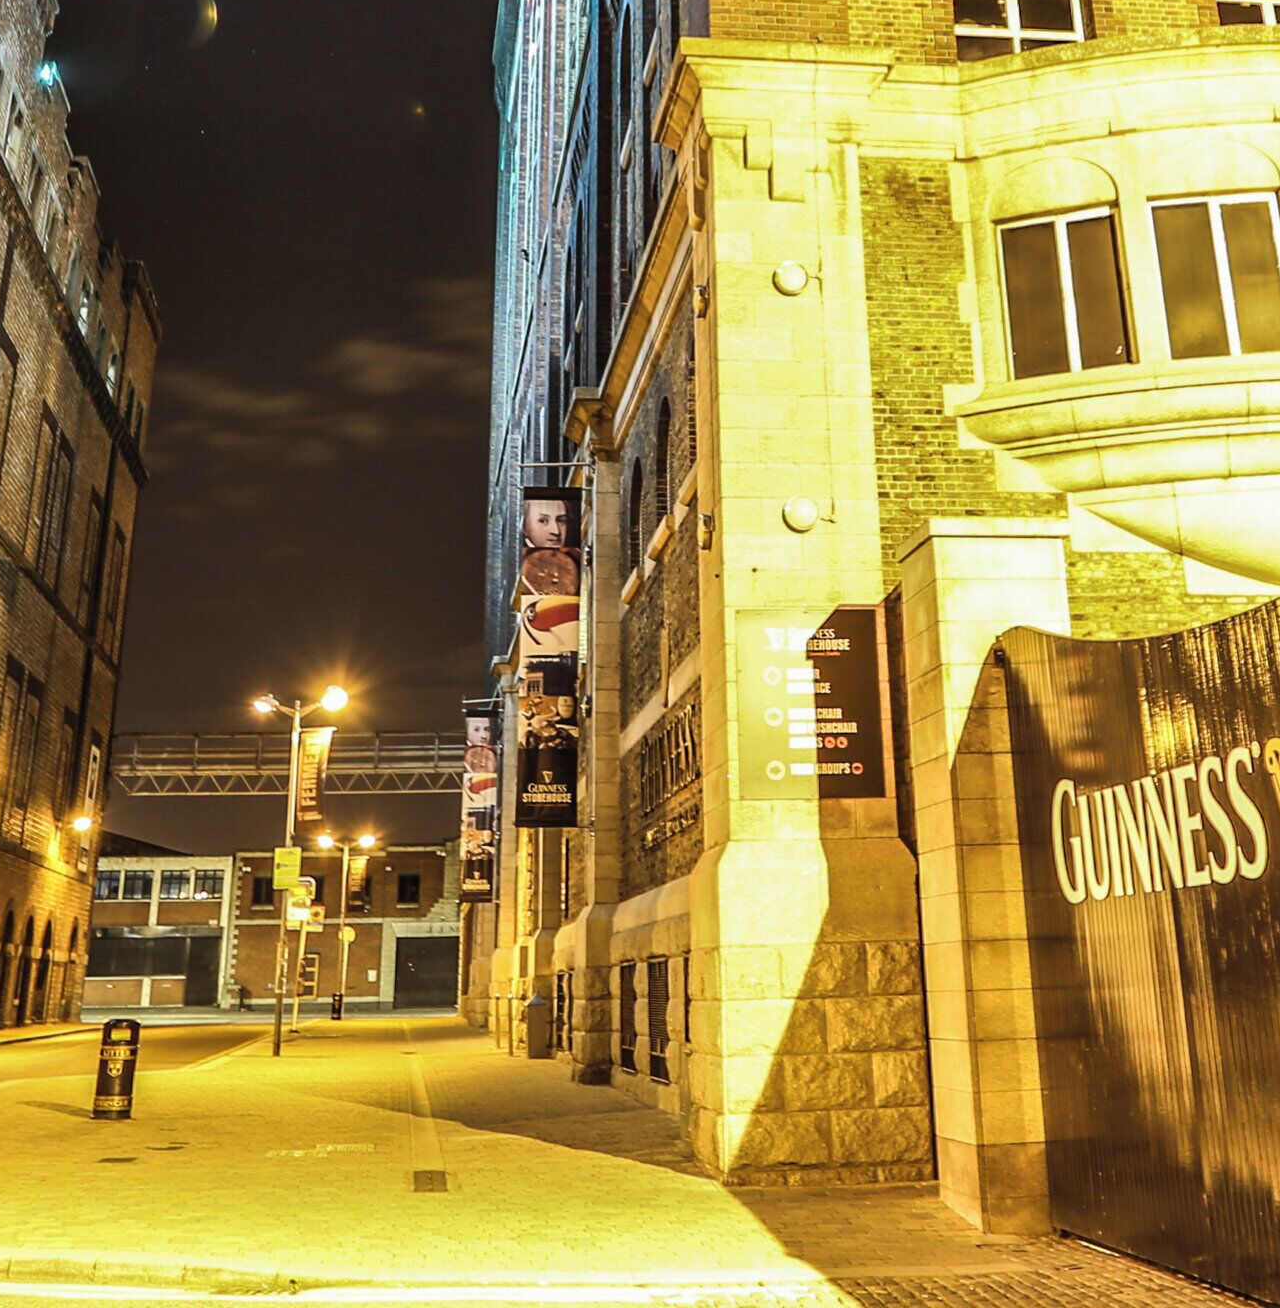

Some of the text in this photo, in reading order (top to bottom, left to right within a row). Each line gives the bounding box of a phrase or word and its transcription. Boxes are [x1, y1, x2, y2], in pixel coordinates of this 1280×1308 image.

[527, 783, 568, 792] GUINNESS
[522, 793, 572, 803] STOREHOUSE
[1051, 747, 1268, 905] GUINNESS
